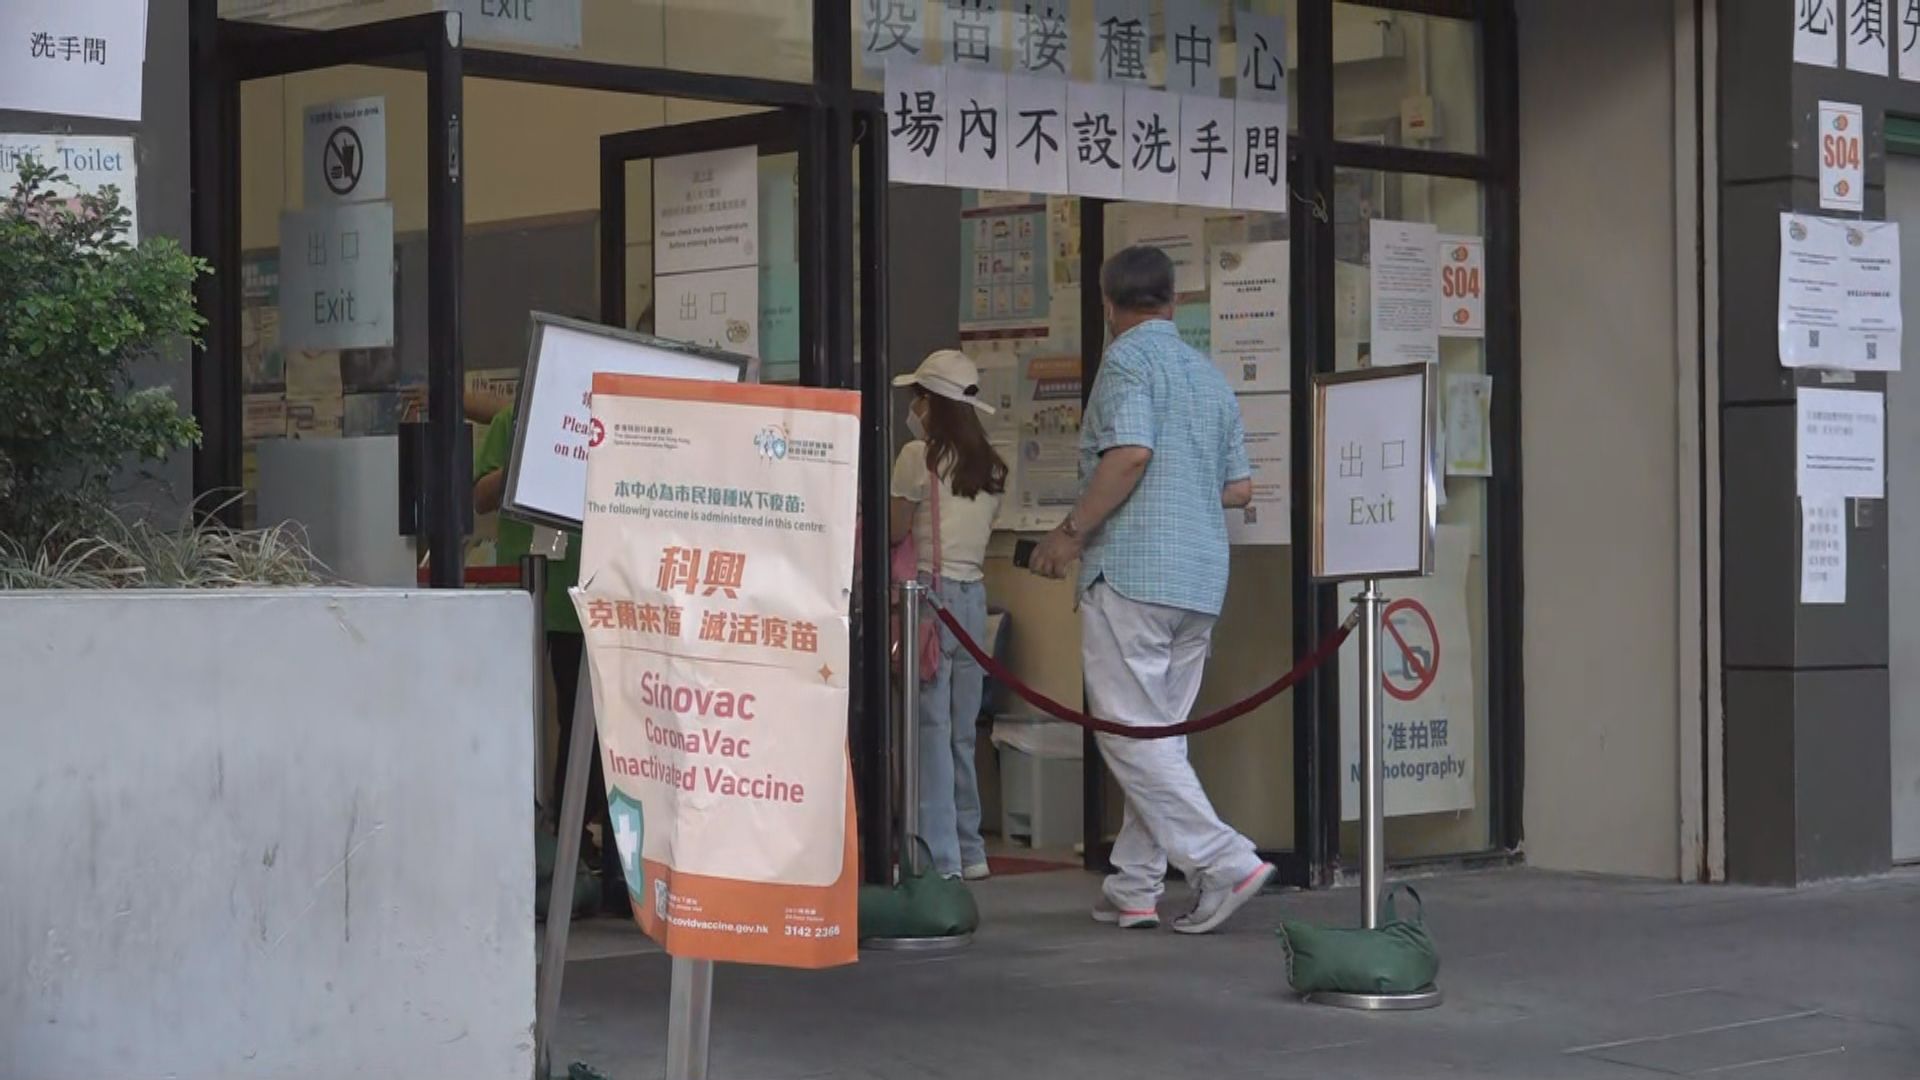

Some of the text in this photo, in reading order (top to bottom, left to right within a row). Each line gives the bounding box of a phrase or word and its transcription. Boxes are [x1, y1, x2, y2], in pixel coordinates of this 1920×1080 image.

[29, 32, 107, 65] 洗手間
[890, 90, 1281, 186] 場內不設洗手間
[57, 147, 122, 172] Toilet
[313, 289, 355, 325] Exit
[554, 444, 570, 457] on
[588, 502, 607, 514] The
[653, 508, 690, 521] vaccine
[691, 510, 699, 522] is
[701, 511, 764, 529] administered
[764, 517, 774, 528] in
[775, 517, 793, 531] this
[794, 520, 827, 534] centre:
[1349, 494, 1396, 526] Exit
[656, 545, 747, 600] 科興
[588, 598, 818, 653] 克爾來福 滅活疫苗
[641, 671, 756, 720] Sinovac
[644, 718, 751, 759] CoronaVac
[1380, 719, 1449, 751] 准拍照
[609, 748, 805, 804] Inactivated Vaccine
[1382, 754, 1466, 782] hotography
[784, 924, 812, 937] 3142
